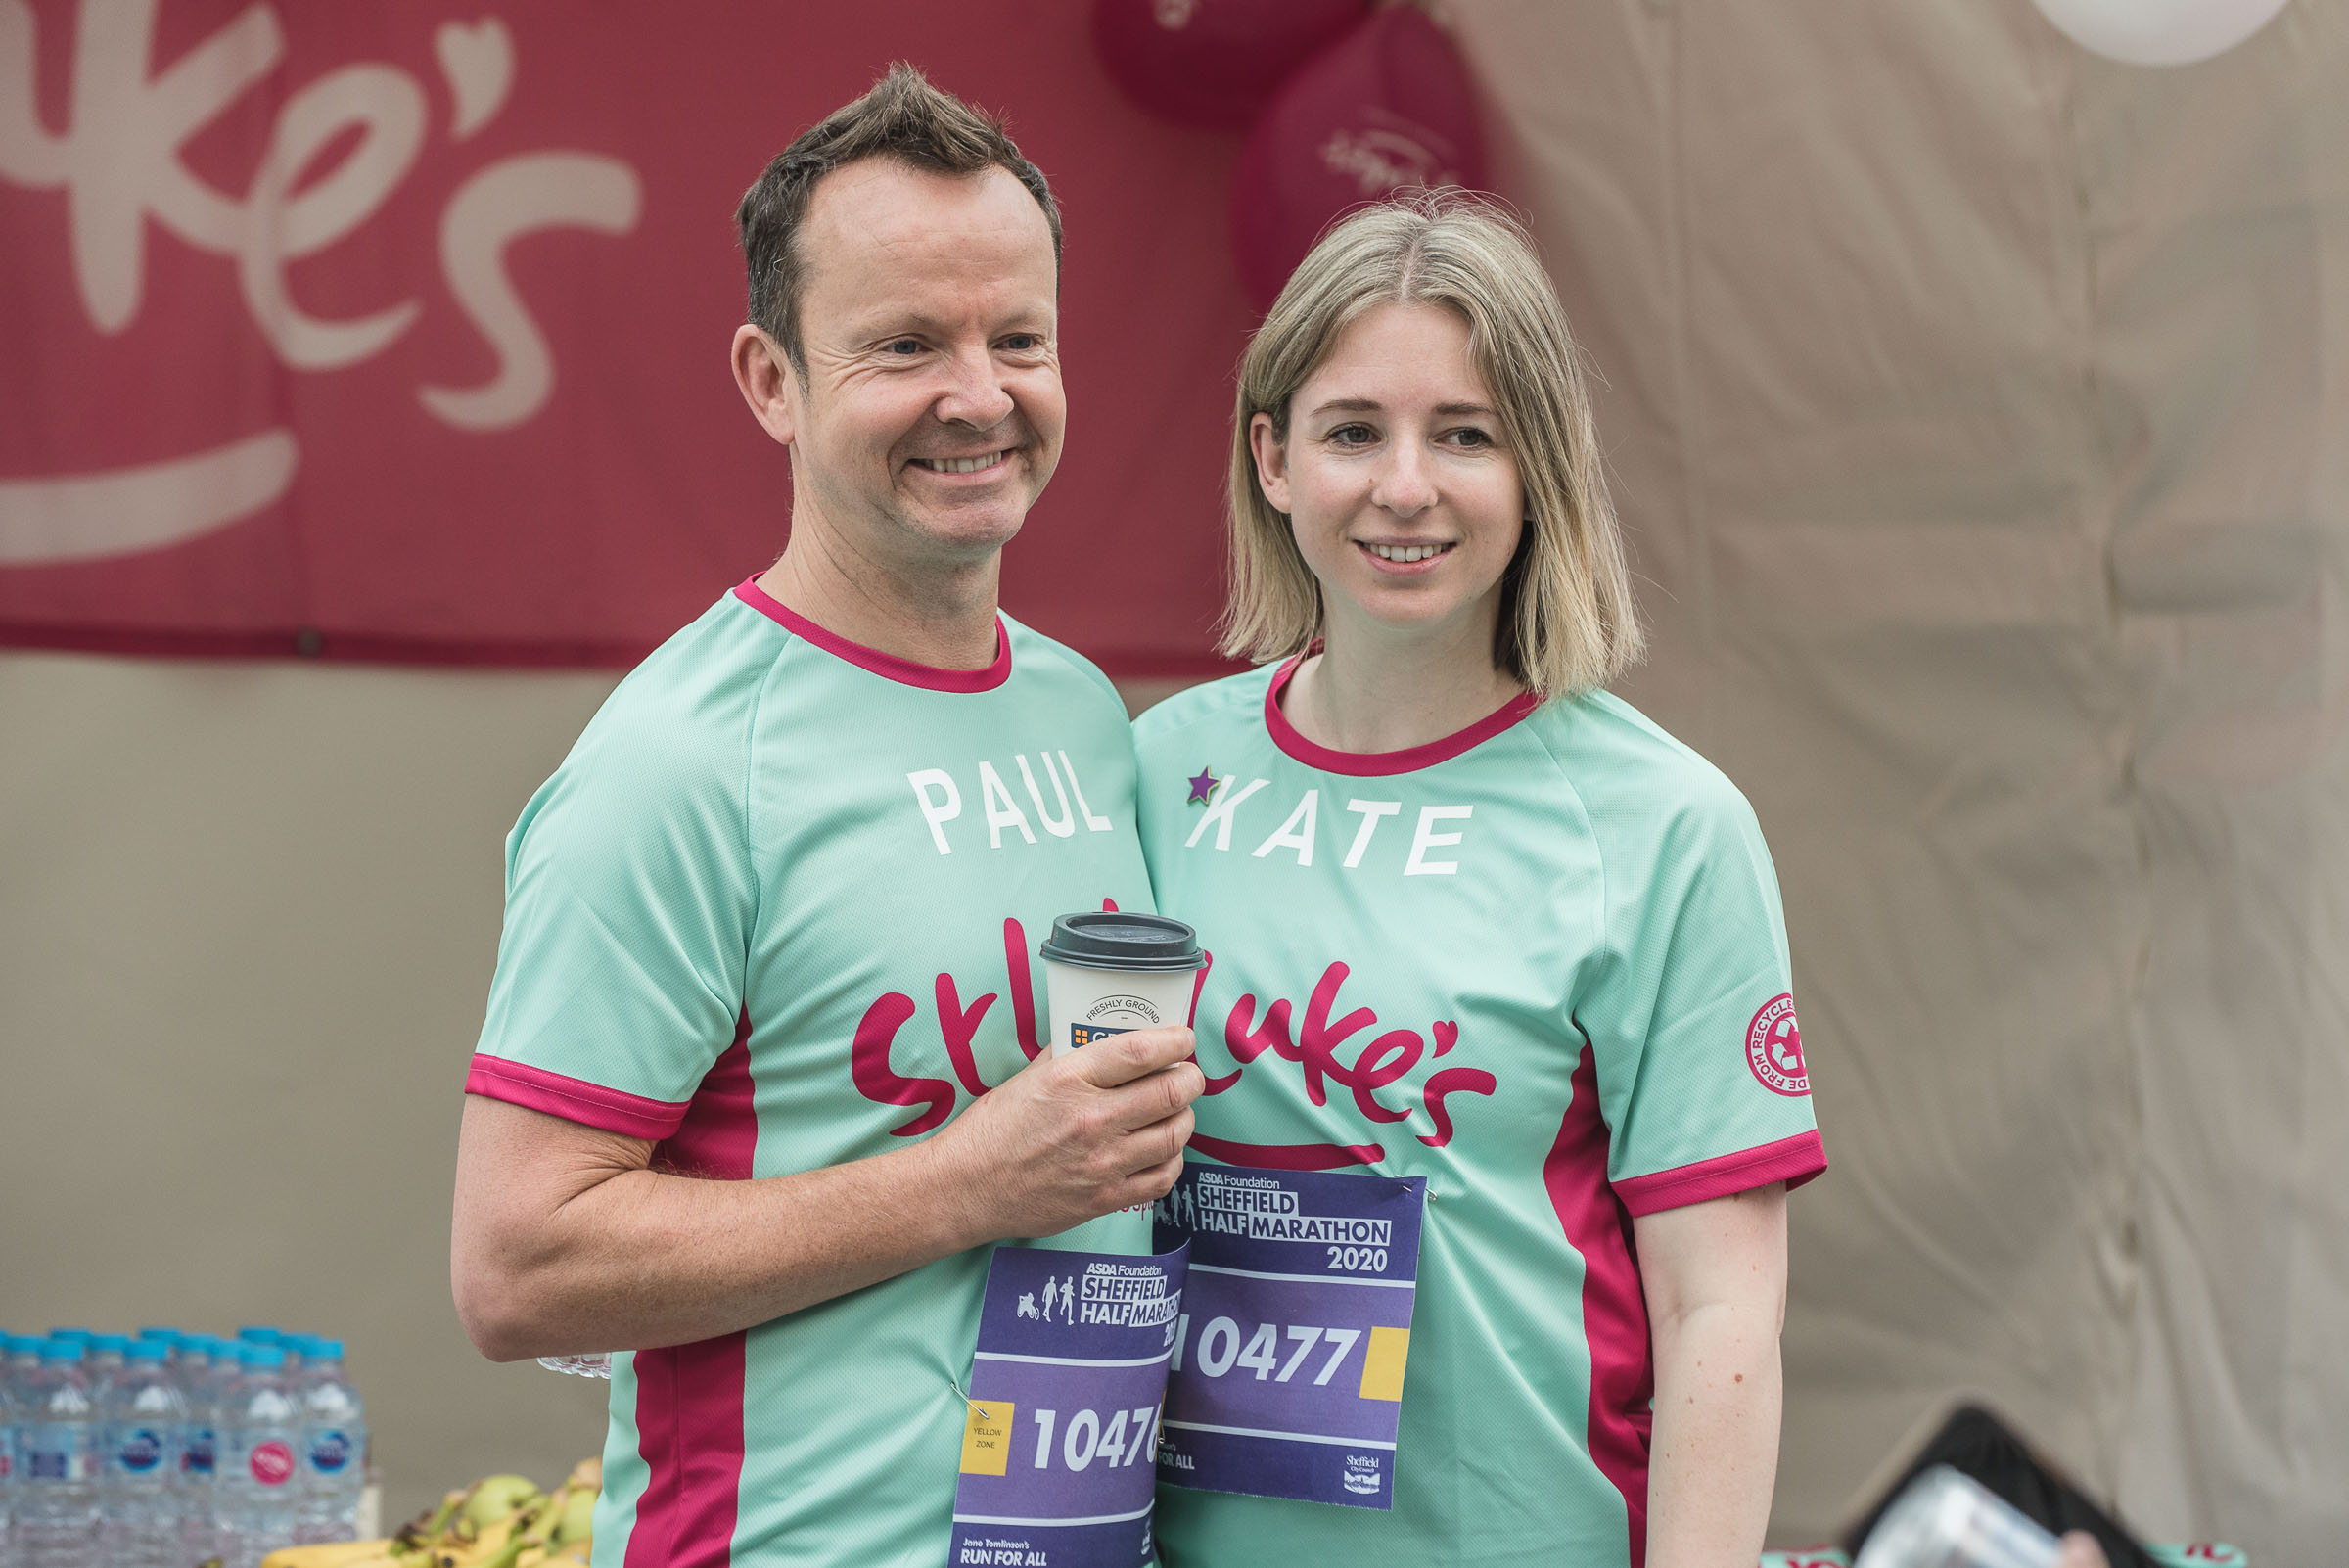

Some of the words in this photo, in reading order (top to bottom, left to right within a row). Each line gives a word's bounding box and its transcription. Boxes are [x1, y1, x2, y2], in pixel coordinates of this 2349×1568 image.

[905, 750, 1114, 855] PAUL
[1185, 774, 1473, 876] KATE
[1086, 999, 1123, 1021] FRESHLY
[1125, 999, 1160, 1024] GROUND
[1753, 999, 1794, 1049] RECYCLE
[1754, 1053, 1785, 1087] FROM
[1788, 1079, 1809, 1089] DE
[1198, 1172, 1223, 1185] ASDA
[1224, 1175, 1280, 1190] Foundation
[1200, 1185, 1295, 1214] SHEFFIELD
[1201, 1210, 1248, 1235] HALF
[1252, 1216, 1388, 1244] MARATHON
[1086, 1262, 1117, 1276] ASDA
[1118, 1265, 1162, 1277] Foundation
[1327, 1245, 1388, 1272] 2020
[1082, 1277, 1165, 1301] SHEFFIELD
[1080, 1302, 1130, 1325] HALF
[974, 1427, 1002, 1437] YELLOW
[976, 1440, 995, 1449] ZONE
[1175, 1454, 1195, 1470] ALL
[1346, 1455, 1379, 1468] Sheffield
[963, 1537, 983, 1547] Jane
[985, 1538, 1030, 1549] Tomlinson's
[960, 1548, 993, 1565] RUN
[994, 1550, 1023, 1566] FOR
[1025, 1551, 1047, 1567] ALL
